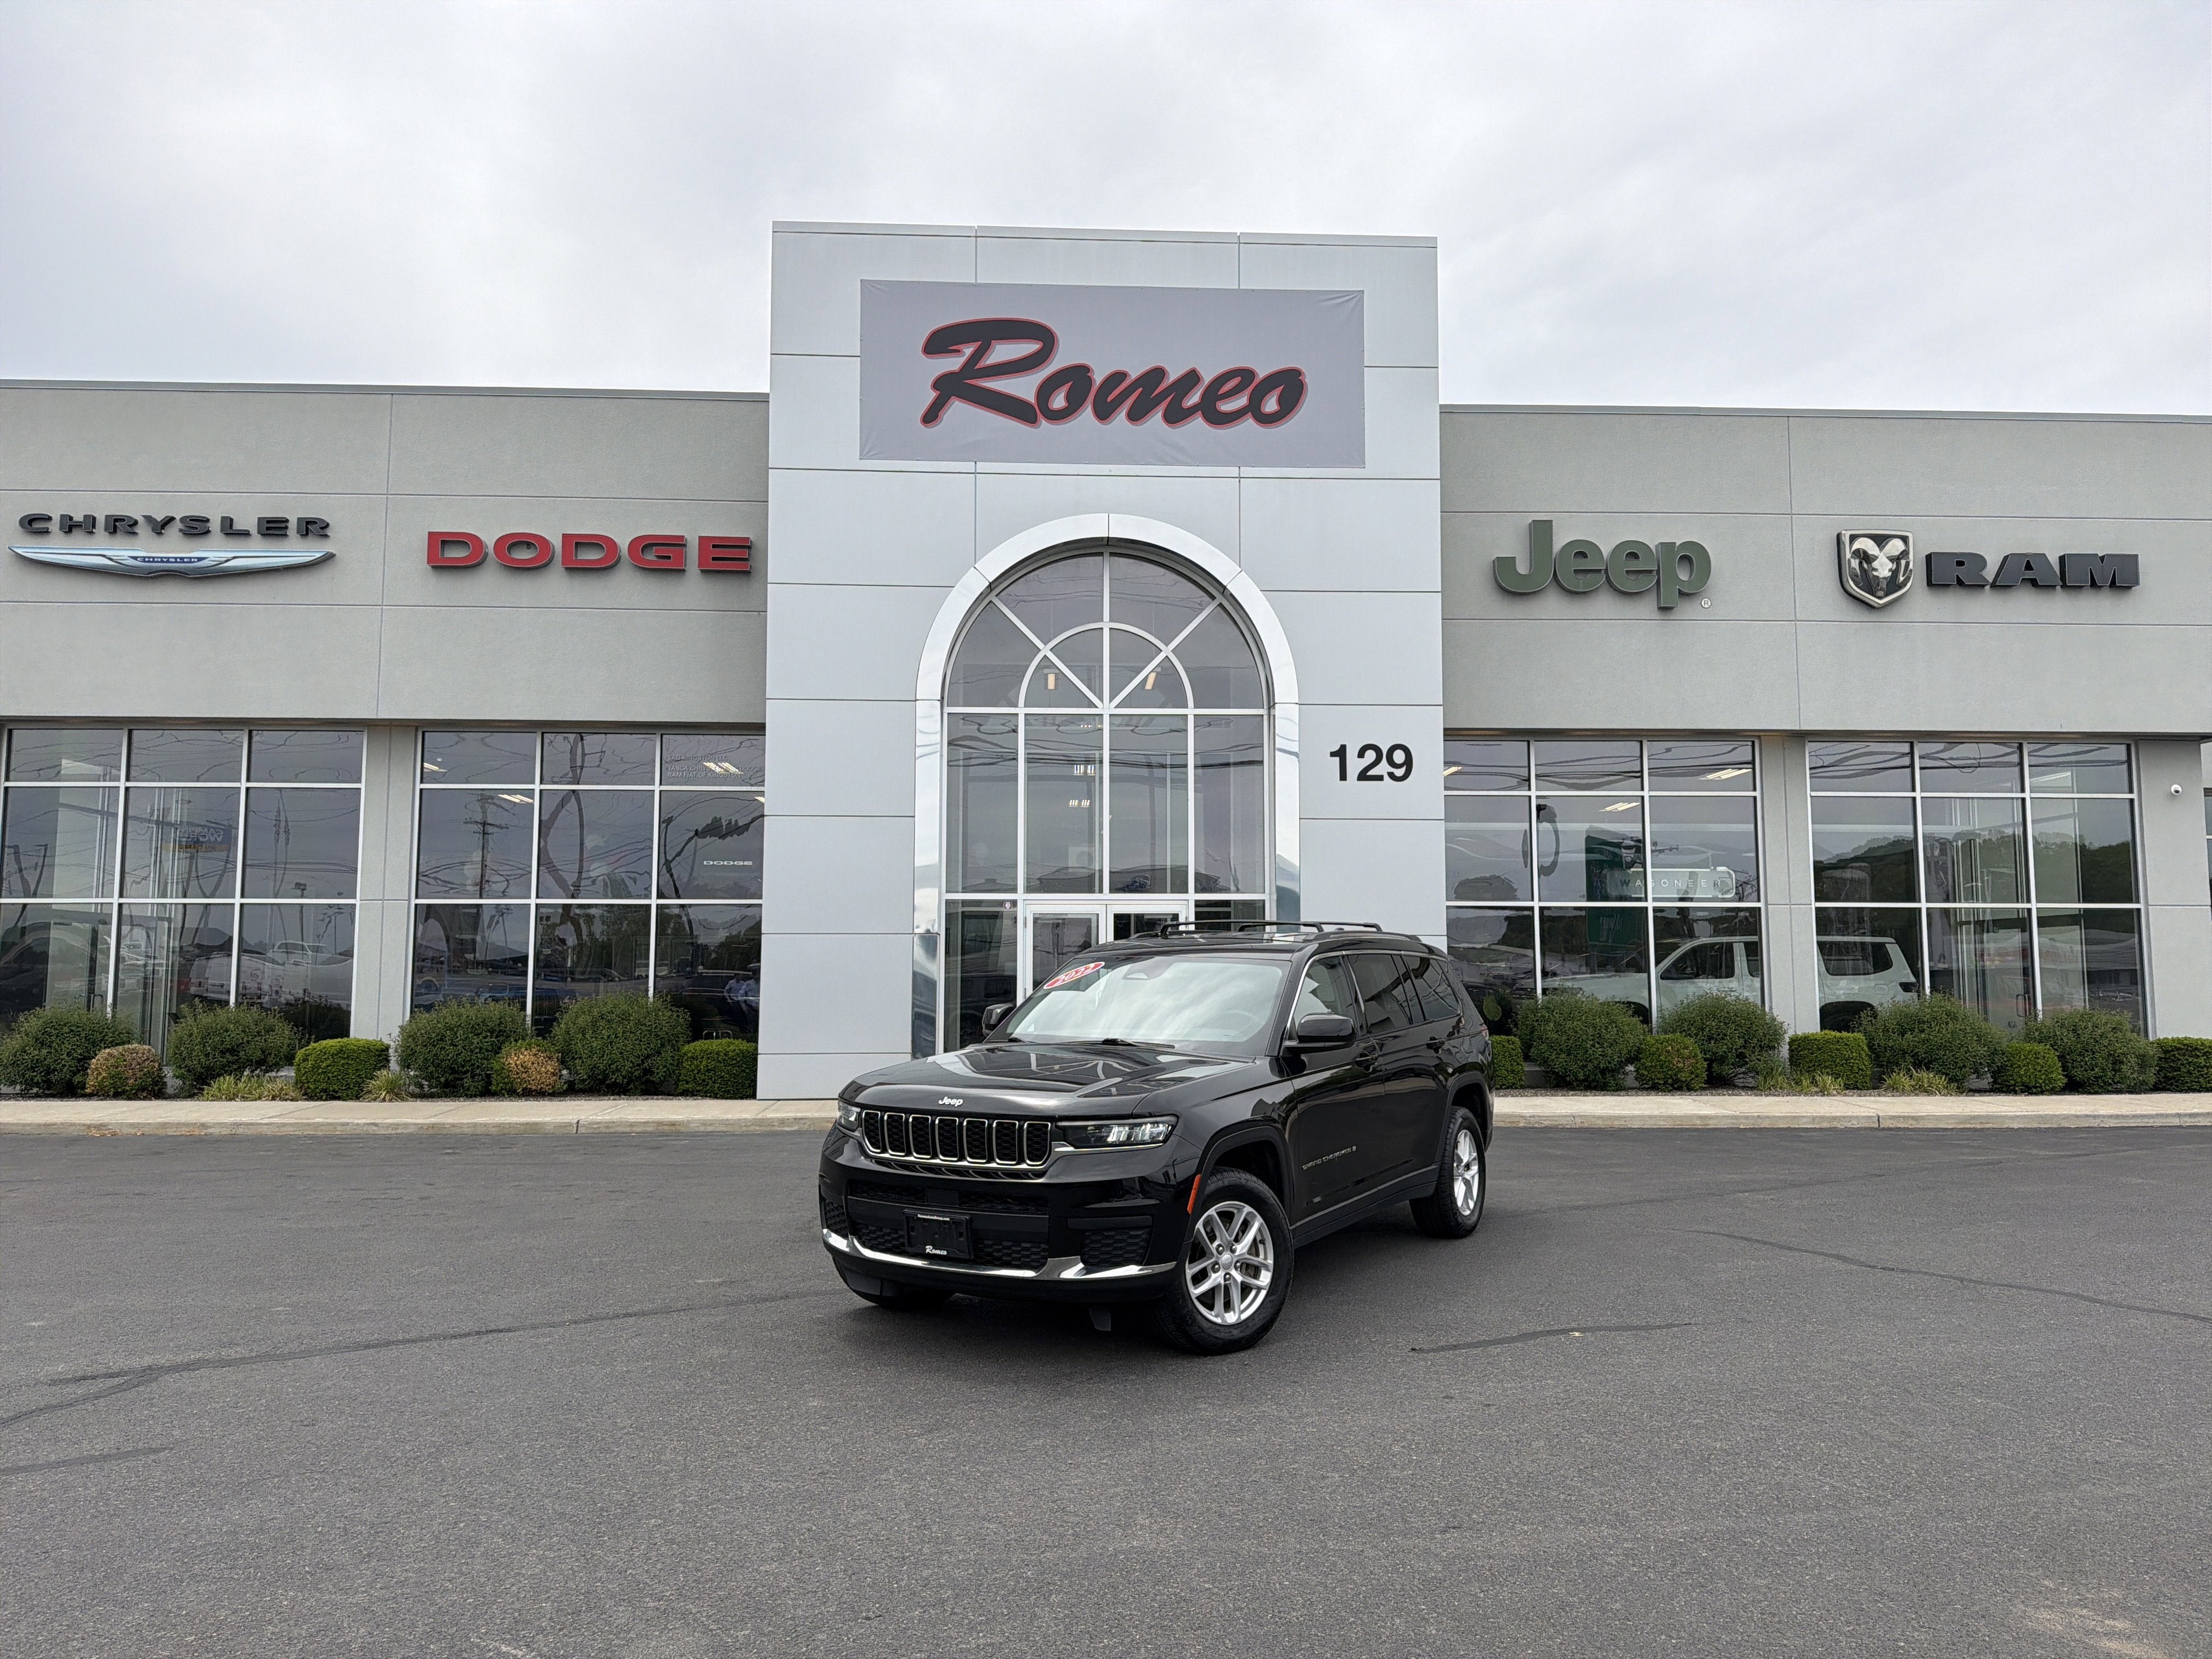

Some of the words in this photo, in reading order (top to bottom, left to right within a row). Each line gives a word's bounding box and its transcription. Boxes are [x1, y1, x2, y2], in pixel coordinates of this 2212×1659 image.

[921, 317, 1307, 428] Romeo
[19, 513, 330, 537] CHRYSLER
[427, 531, 753, 571] DODGE
[1493, 520, 1712, 609] Jeep
[1925, 552, 2140, 587] RAM
[1330, 743, 1413, 782] 129
[938, 1096, 963, 1107] Jeep
[925, 1245, 947, 1255] Romeo
